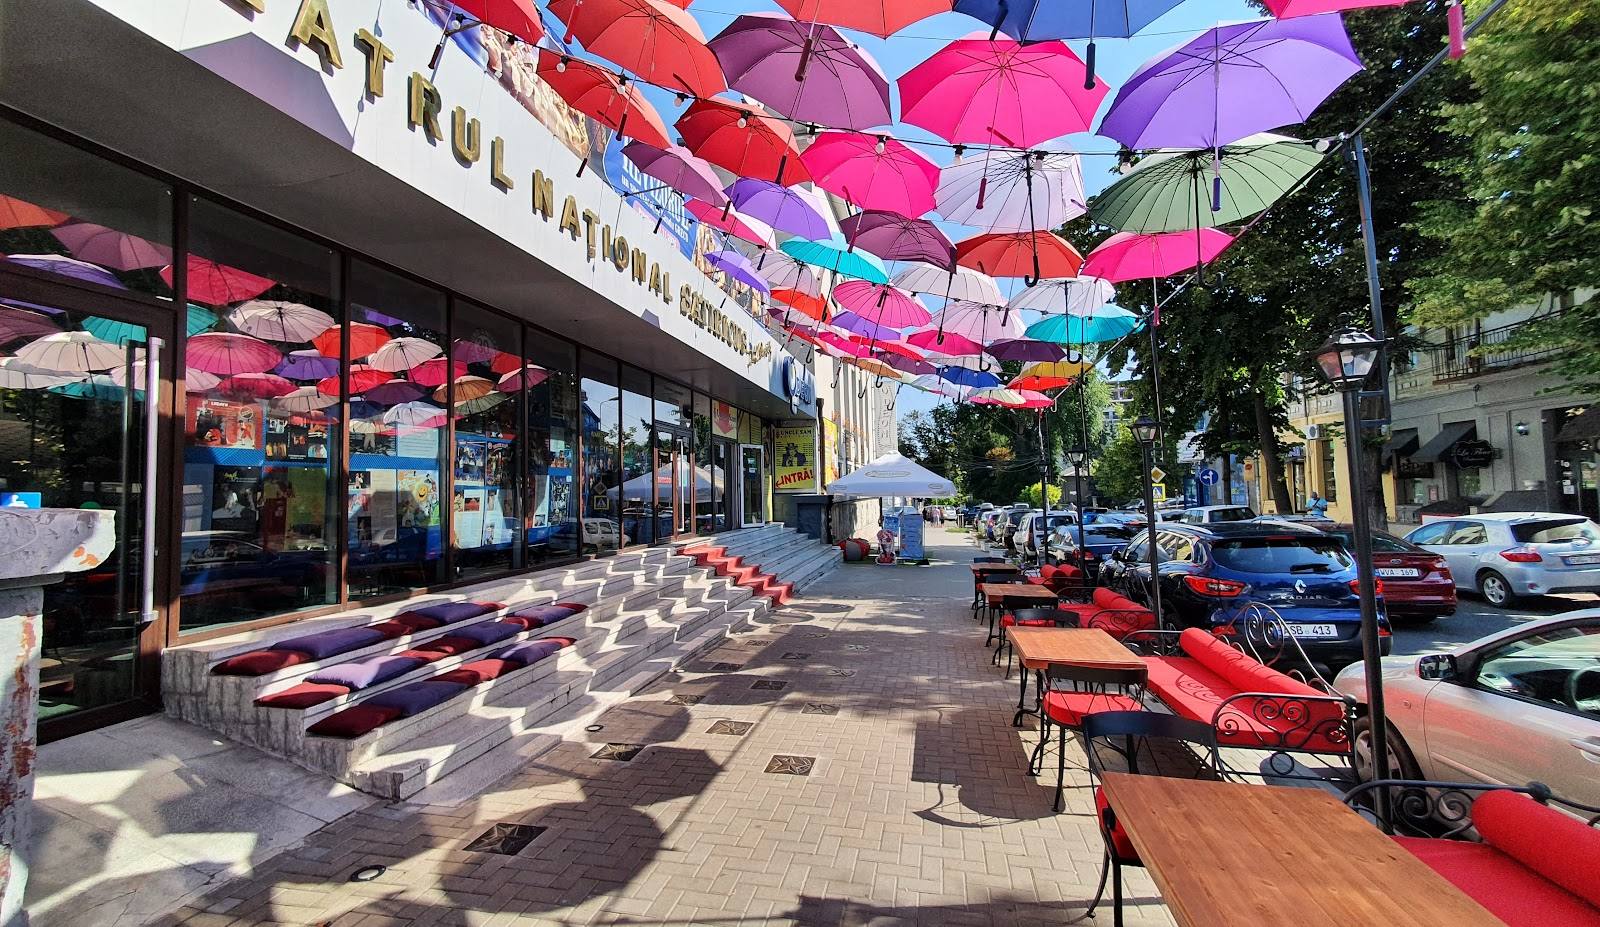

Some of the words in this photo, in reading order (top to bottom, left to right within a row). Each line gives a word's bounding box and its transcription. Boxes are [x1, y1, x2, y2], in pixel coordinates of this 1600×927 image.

[219, 0, 514, 190] ATRUL
[780, 468, 813, 486] INTRĂ!
[1312, 625, 1332, 635] 413
